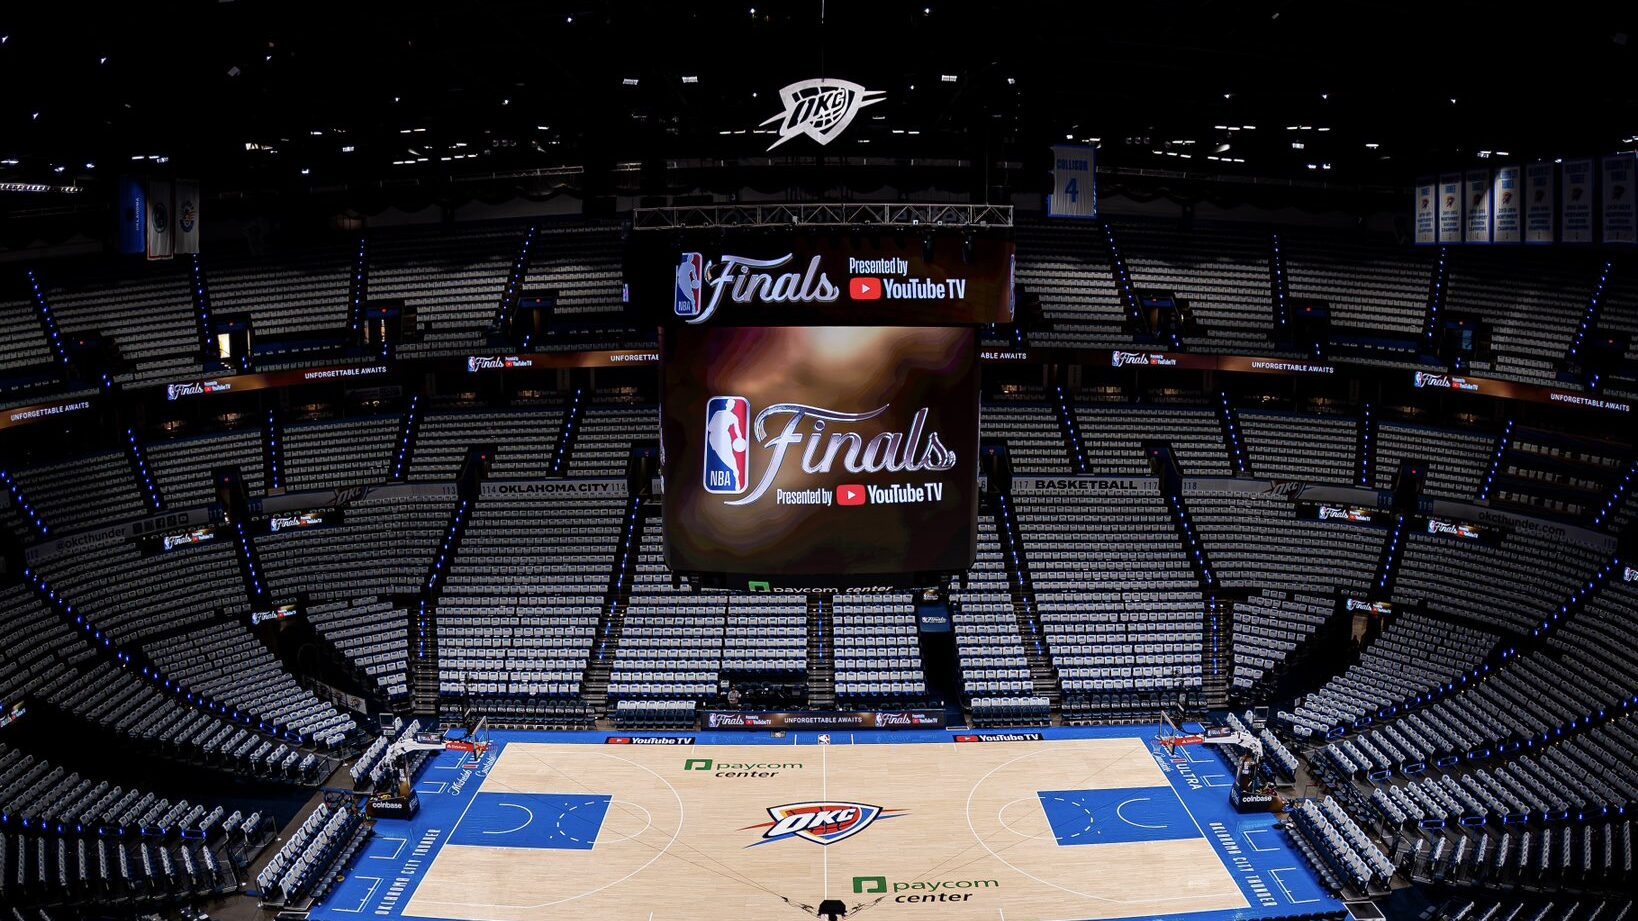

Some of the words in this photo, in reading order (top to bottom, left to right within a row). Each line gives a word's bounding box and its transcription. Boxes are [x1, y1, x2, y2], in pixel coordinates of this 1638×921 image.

[787, 87, 845, 129] OKC
[1065, 178, 1079, 203] 4
[849, 256, 895, 274] Presented
[897, 256, 908, 276] by
[685, 252, 839, 325] Finals
[883, 277, 945, 299] YouTube
[946, 278, 966, 299] TV
[678, 300, 691, 311] NBA
[1000, 352, 1027, 360] AWAITS
[1119, 352, 1149, 367] Finals
[474, 356, 504, 372] Finals
[1251, 361, 1306, 372] UNFORGETTABLE
[1308, 365, 1334, 374] AWAITS
[304, 368, 360, 379] UNFORGETTABLE
[361, 366, 387, 375] AWAITS
[1421, 373, 1451, 388] Finals
[174, 382, 204, 400] Finals
[1550, 393, 1604, 408] UNFORGETTABLE
[1605, 402, 1630, 412] AWAITS
[10, 405, 63, 421] UNFORGETTABLE
[65, 401, 90, 412] AWAITS
[724, 403, 956, 506] Finals
[710, 470, 731, 487] NBA
[1013, 480, 1028, 490] 117
[1035, 480, 1138, 490] BASKETBALL
[1143, 481, 1158, 490] 117
[1183, 481, 1196, 490] 118
[442, 486, 456, 495] 113
[482, 485, 496, 494] 114
[498, 483, 576, 494] OKLAHOMA
[578, 483, 609, 492] CITY
[611, 482, 626, 492] 114
[868, 485, 924, 505] YouTube
[925, 482, 943, 502] TV
[776, 488, 820, 505] Presented
[821, 487, 833, 507] by
[1478, 510, 1566, 536] okcthunder.com
[56, 528, 127, 549] @okcthunder
[716, 713, 745, 727] Finals
[883, 713, 911, 727] Finals
[632, 737, 675, 745] YouTube
[676, 737, 692, 745] TV
[979, 734, 1024, 742] YouTube
[1024, 733, 1039, 741] TV
[716, 763, 803, 771] paycom
[1175, 763, 1202, 791] ULTRA
[372, 801, 402, 809] coinbase
[1242, 795, 1273, 803] coinbase
[767, 808, 857, 836] OKC
[375, 878, 410, 915] OKLAHOMA
[401, 859, 422, 875] CITY
[412, 829, 441, 856] THUNDER
[1209, 822, 1242, 855] OKLAHOMA
[1233, 857, 1254, 872] CITY
[1245, 875, 1278, 907] THUNDER
[893, 879, 999, 892] paycom
[895, 892, 973, 904] center
